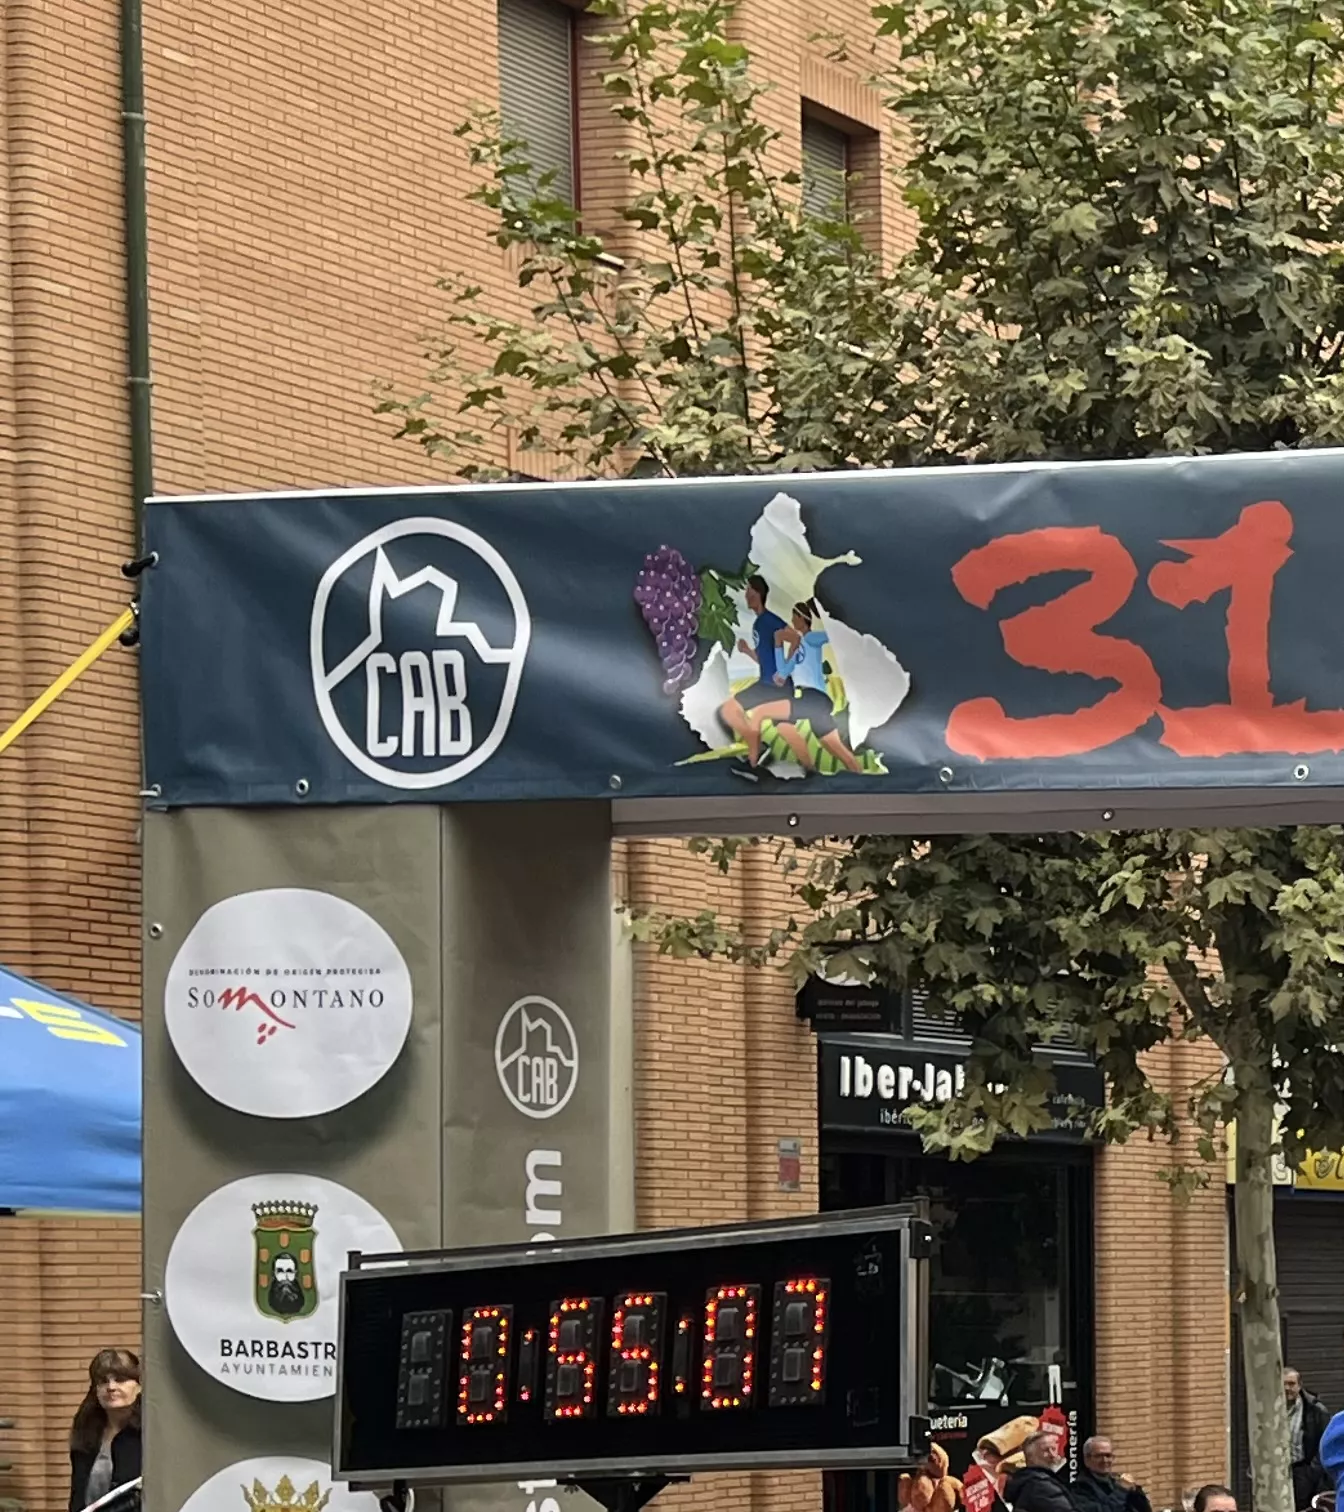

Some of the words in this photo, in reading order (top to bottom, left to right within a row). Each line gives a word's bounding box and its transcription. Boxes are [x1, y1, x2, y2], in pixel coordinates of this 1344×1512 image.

[366, 650, 473, 759] CAB
[188, 985, 385, 1030] SOMONTANO
[517, 1054, 559, 1106] CAB
[220, 1338, 337, 1361] BARBASTR
[221, 1361, 334, 1378] AYUNTAMIEN
[458, 1277, 827, 1425] 0:55:07
